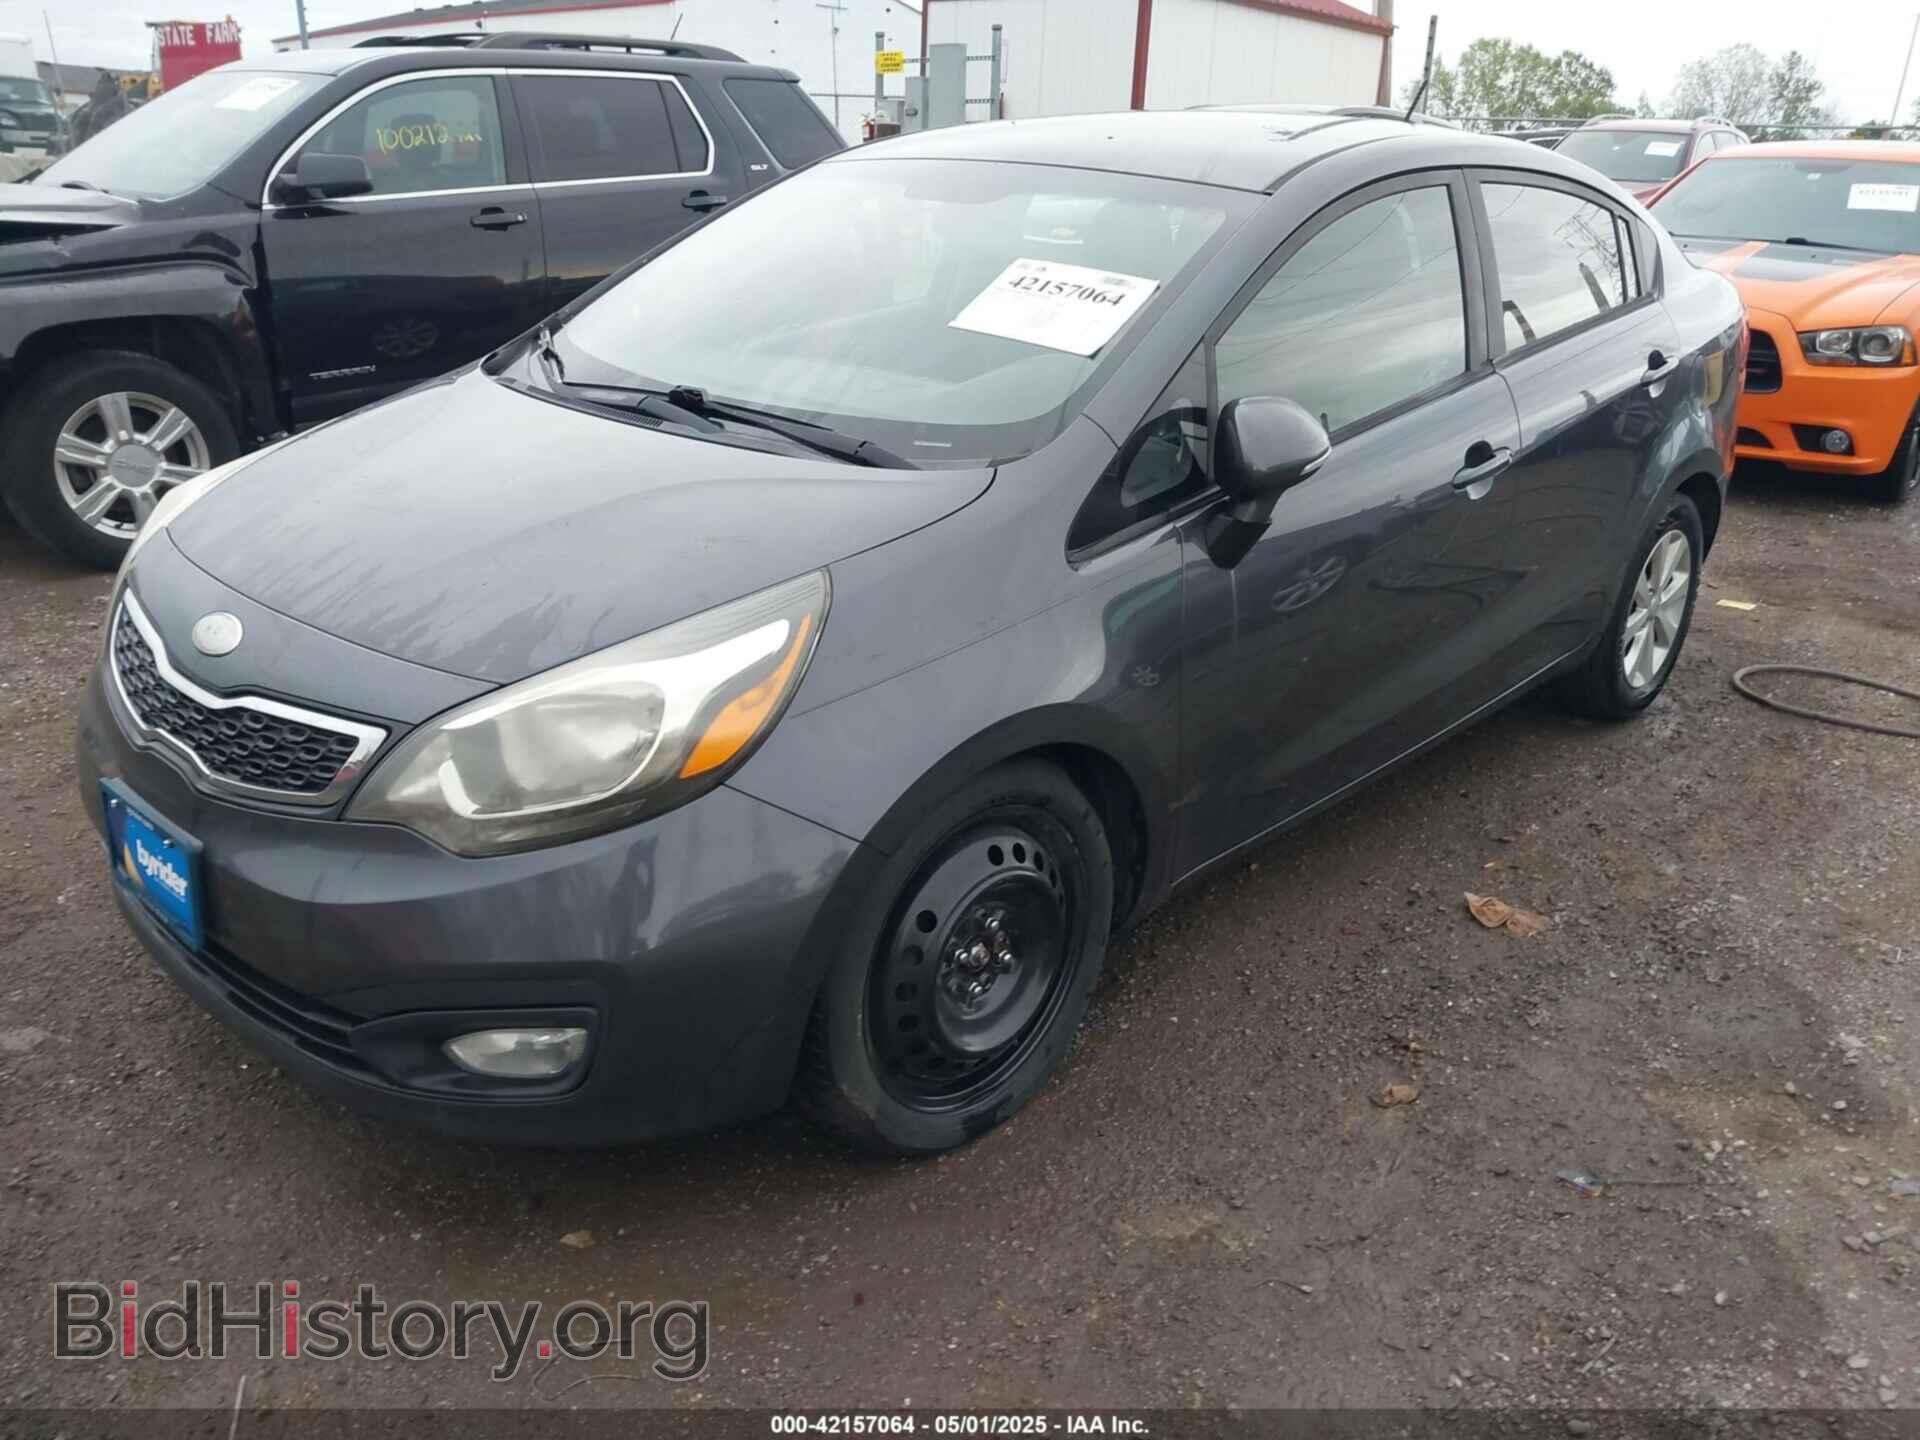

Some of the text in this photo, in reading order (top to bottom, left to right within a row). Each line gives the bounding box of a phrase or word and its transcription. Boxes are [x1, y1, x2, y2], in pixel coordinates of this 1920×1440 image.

[159, 22, 240, 46] STATE FARM
[1008, 275, 1127, 307] 42157064
[136, 838, 188, 897] byrider
